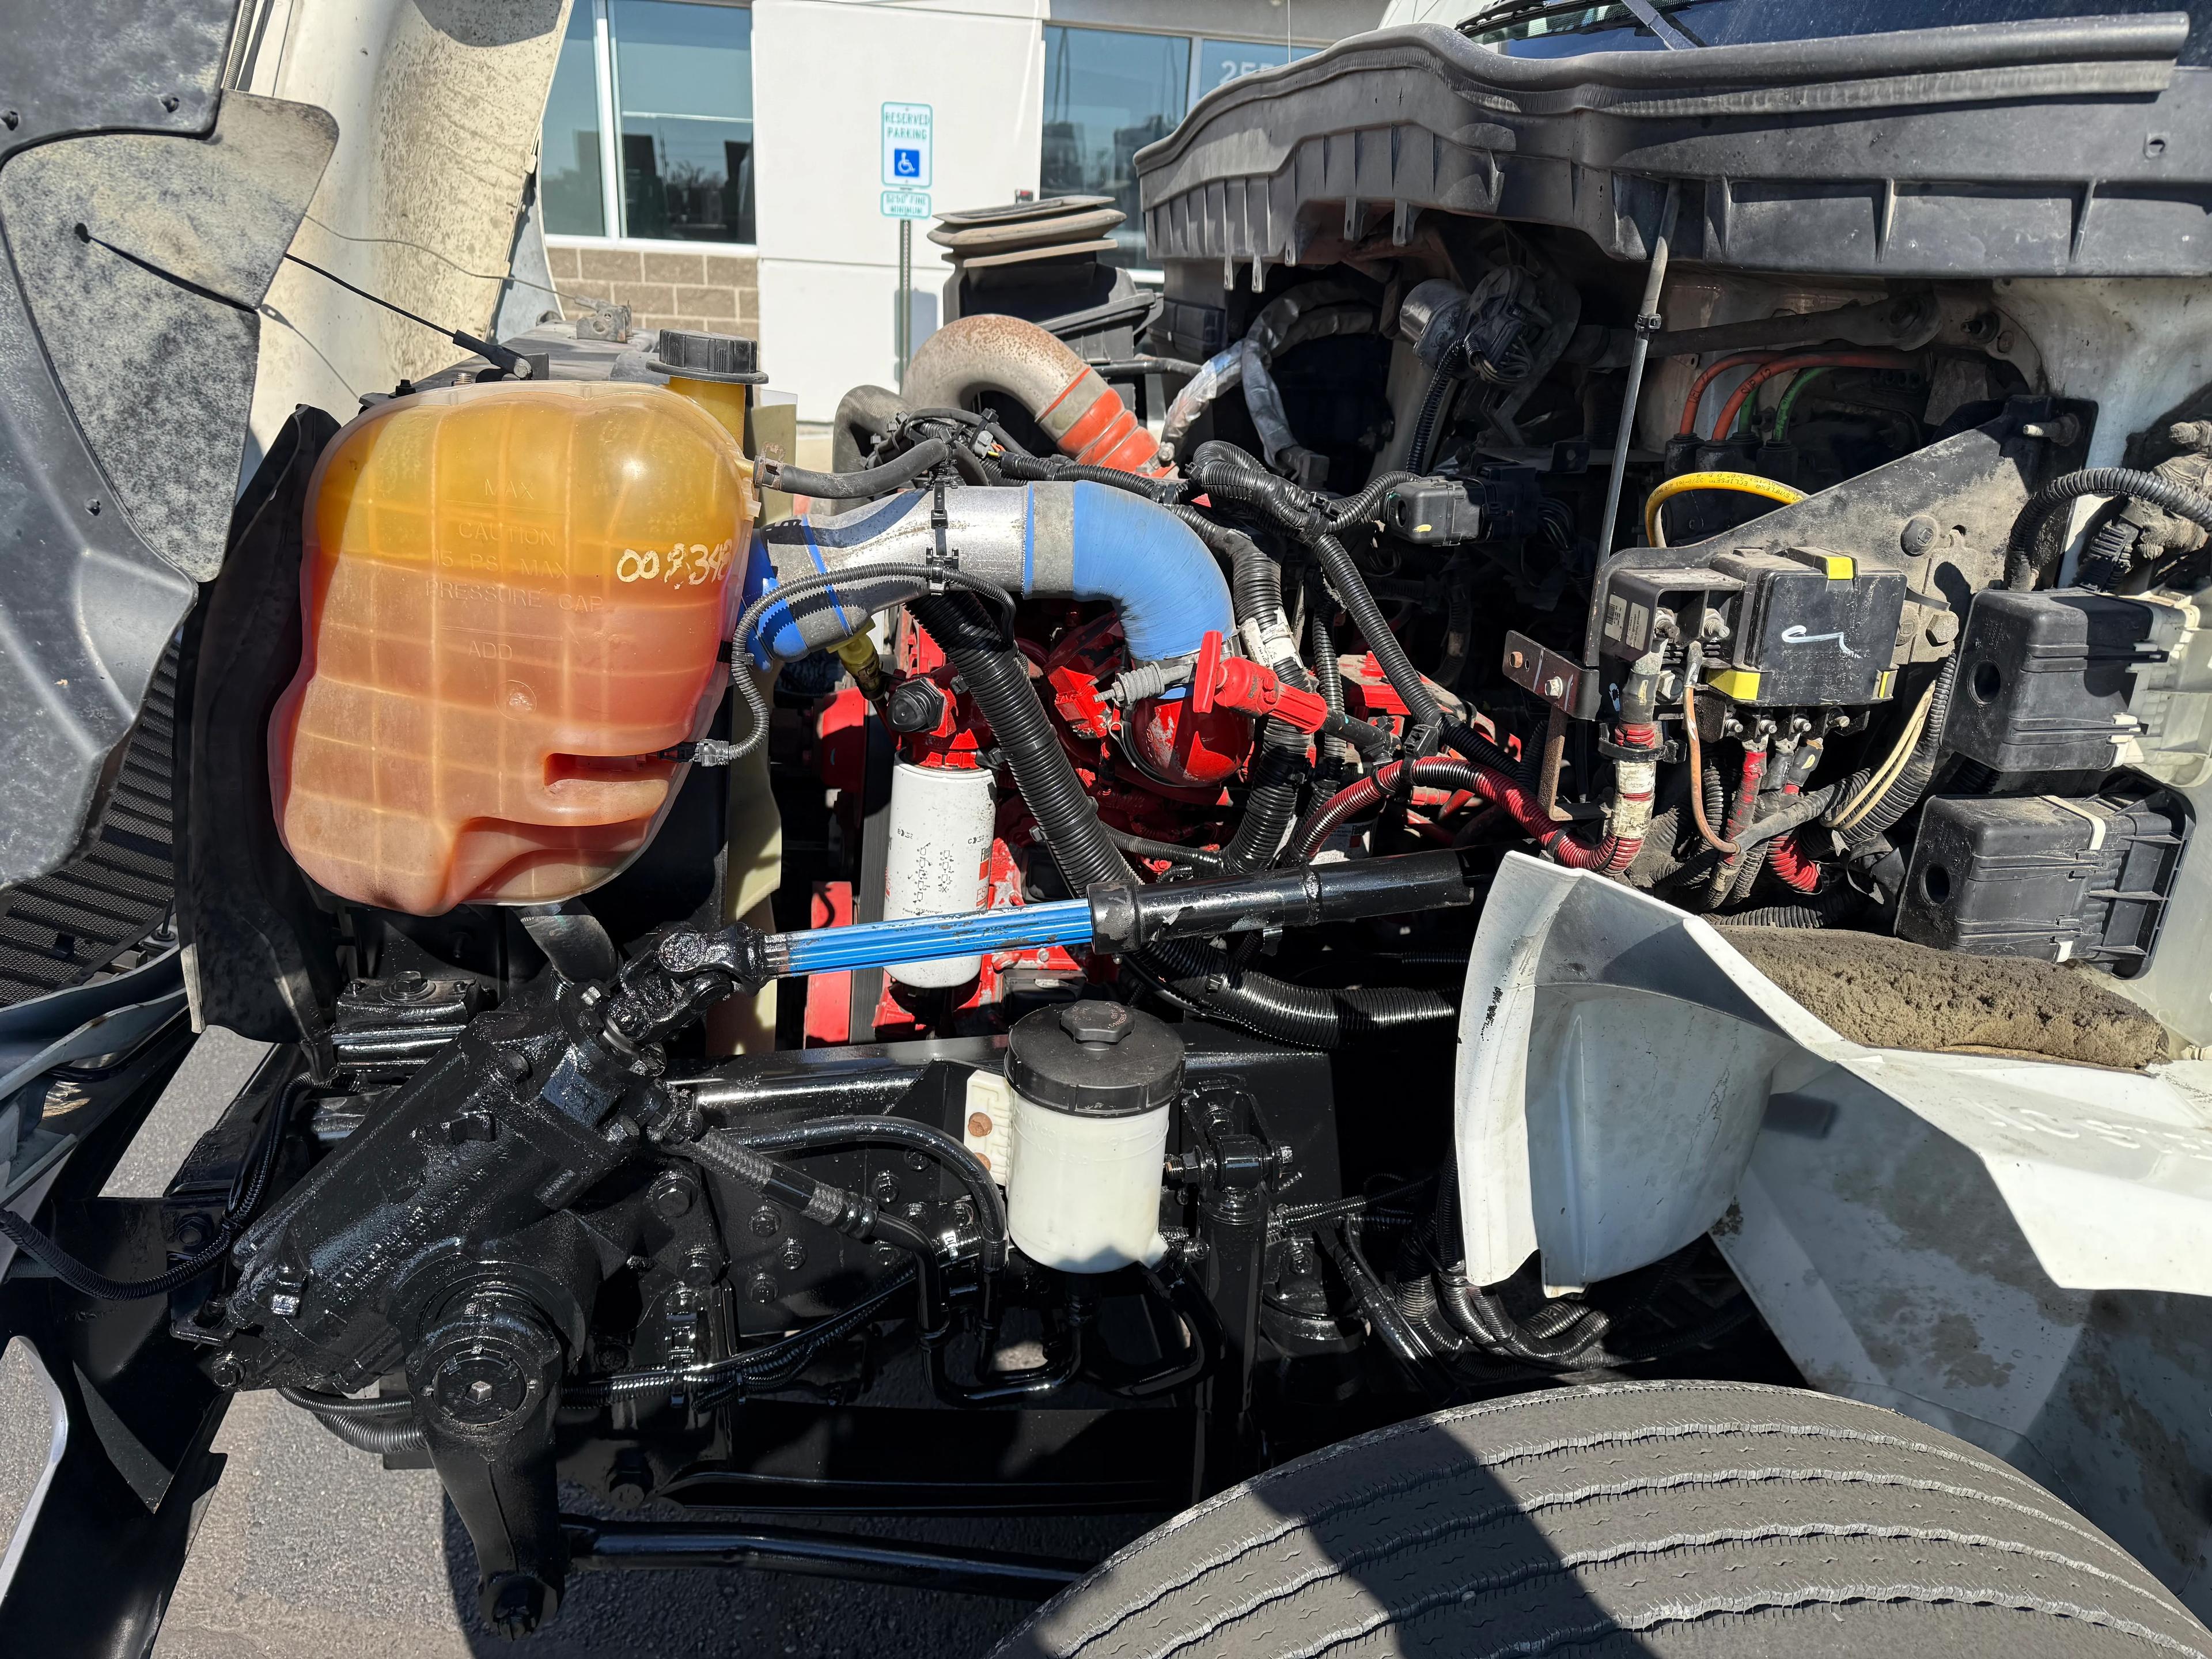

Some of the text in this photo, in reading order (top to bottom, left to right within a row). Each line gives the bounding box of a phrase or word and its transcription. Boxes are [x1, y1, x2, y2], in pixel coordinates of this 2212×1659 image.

[885, 111, 930, 126] RESERVED
[887, 126, 927, 140] PARKING
[890, 204, 923, 215] MINIMUM
[484, 479, 534, 500] MAX
[458, 521, 556, 547] CAUTION
[433, 548, 569, 580] 15 PSI MAX
[425, 579, 604, 613] PRESSURE CAP
[468, 640, 513, 661] ADD
